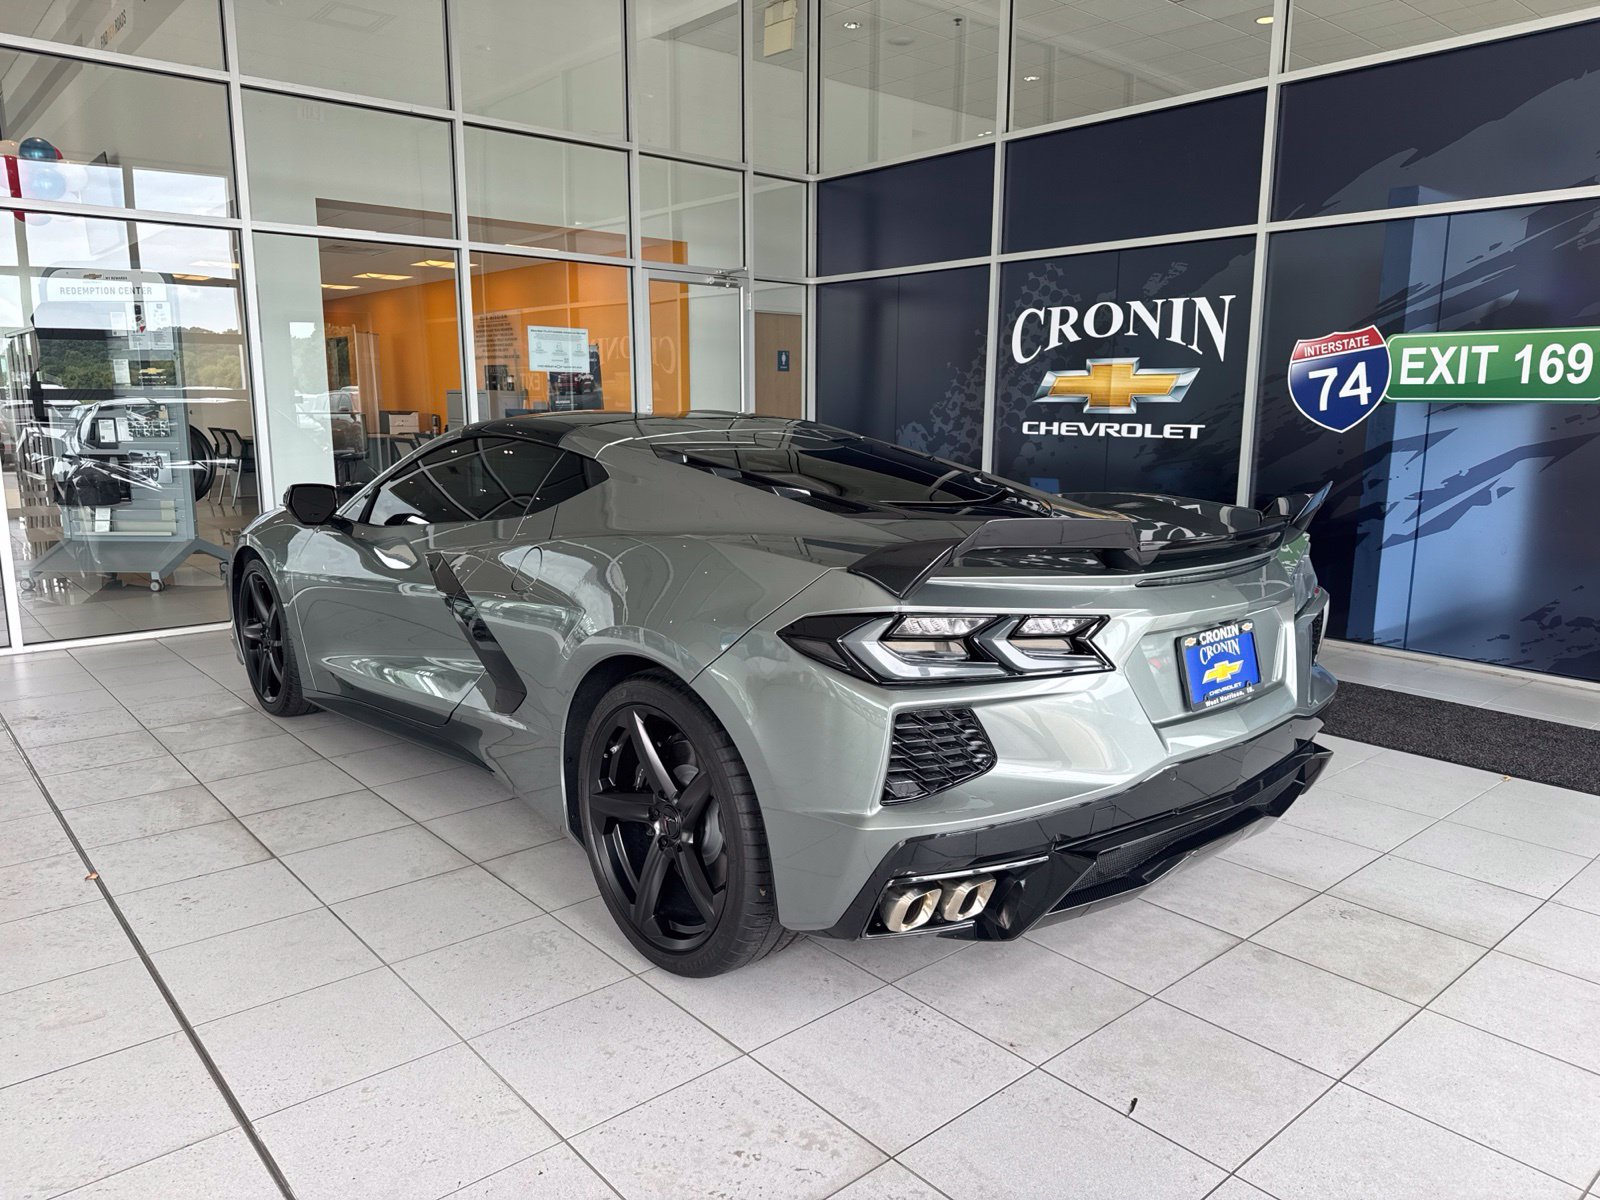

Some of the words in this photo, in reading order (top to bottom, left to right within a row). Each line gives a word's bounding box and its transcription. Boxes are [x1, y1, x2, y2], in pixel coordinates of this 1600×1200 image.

[60, 286, 116, 295] REDEMPTION
[118, 286, 152, 295] CENTER
[1012, 295, 1236, 364] CRONIN
[1304, 335, 1370, 357] INTERSTATE
[1399, 345, 1499, 385] EXIT
[1514, 342, 1594, 385] 169
[1308, 361, 1372, 411] 74
[1022, 421, 1206, 439] CHEVROLET
[1200, 624, 1239, 645] CRONIN
[1200, 638, 1240, 665] CRONIN
[1209, 682, 1242, 696] CHEVROLET
[1205, 698, 1219, 707] West
